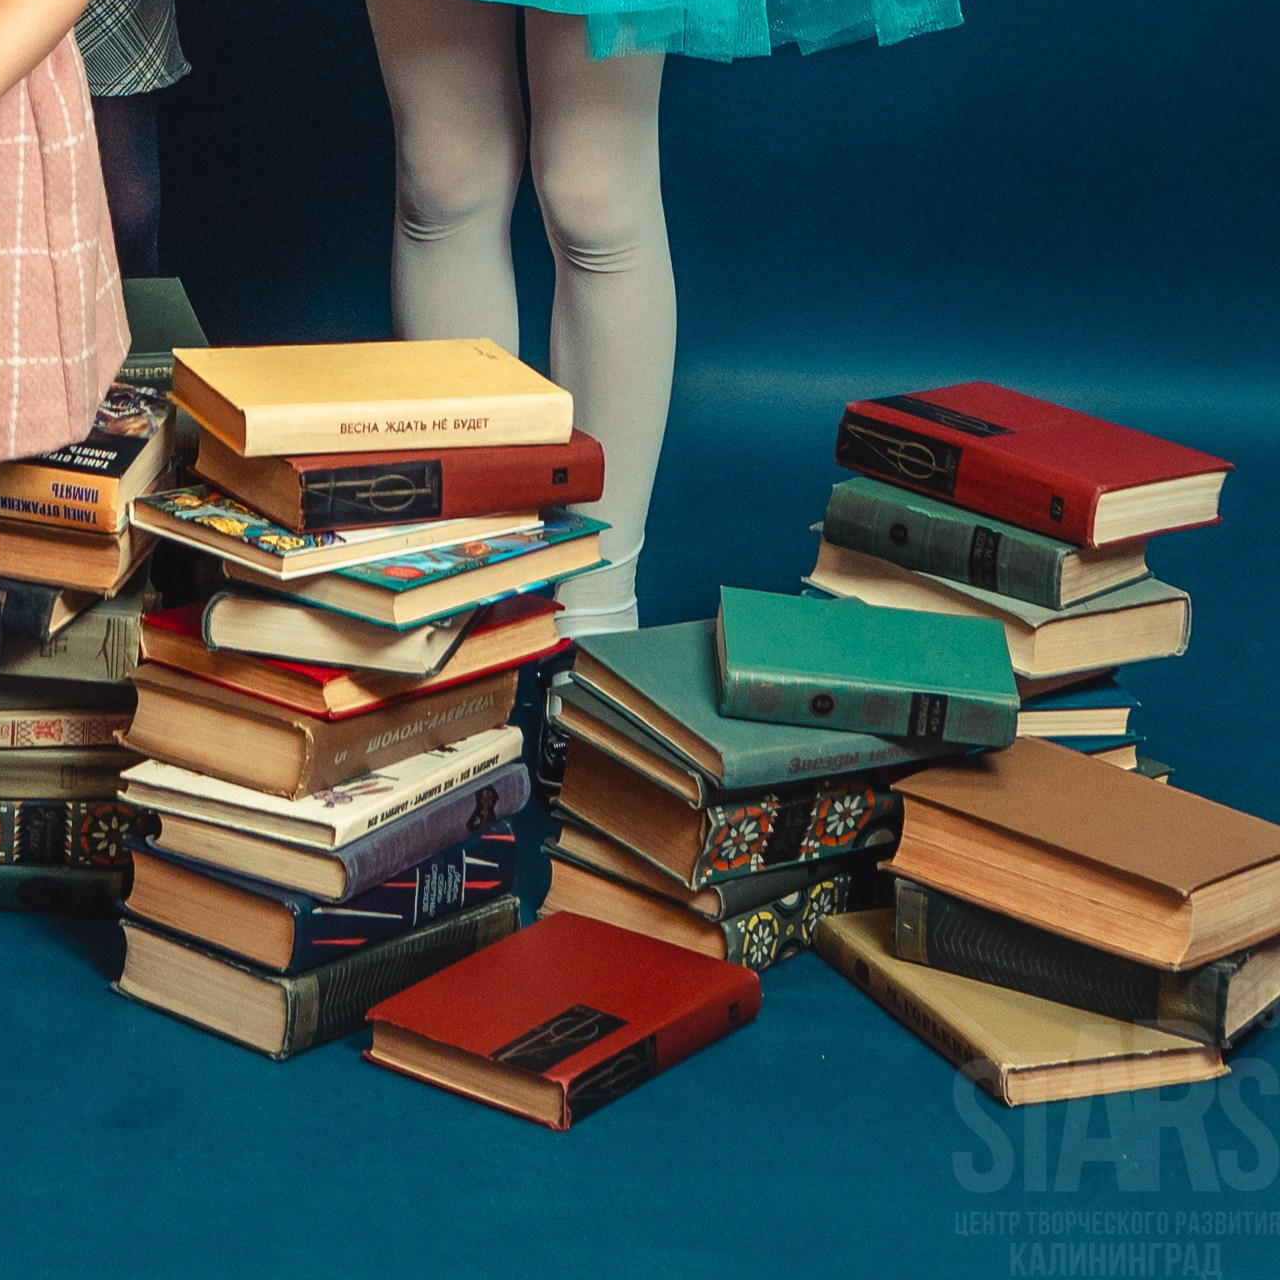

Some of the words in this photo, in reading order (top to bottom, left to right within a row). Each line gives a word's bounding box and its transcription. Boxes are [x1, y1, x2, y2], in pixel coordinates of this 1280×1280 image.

[340, 422, 379, 434] ВЕСНА
[385, 420, 427, 434] ЖДАТЬ
[432, 418, 447, 430] НЕ
[453, 418, 489, 431] БУДЕТ
[70, 445, 117, 460] ПАМЯТЬ
[73, 455, 109, 470] ТАНЕЦ
[52, 483, 98, 503] ПАМЯТЬ
[64, 504, 97, 524] ТАНЕЦ
